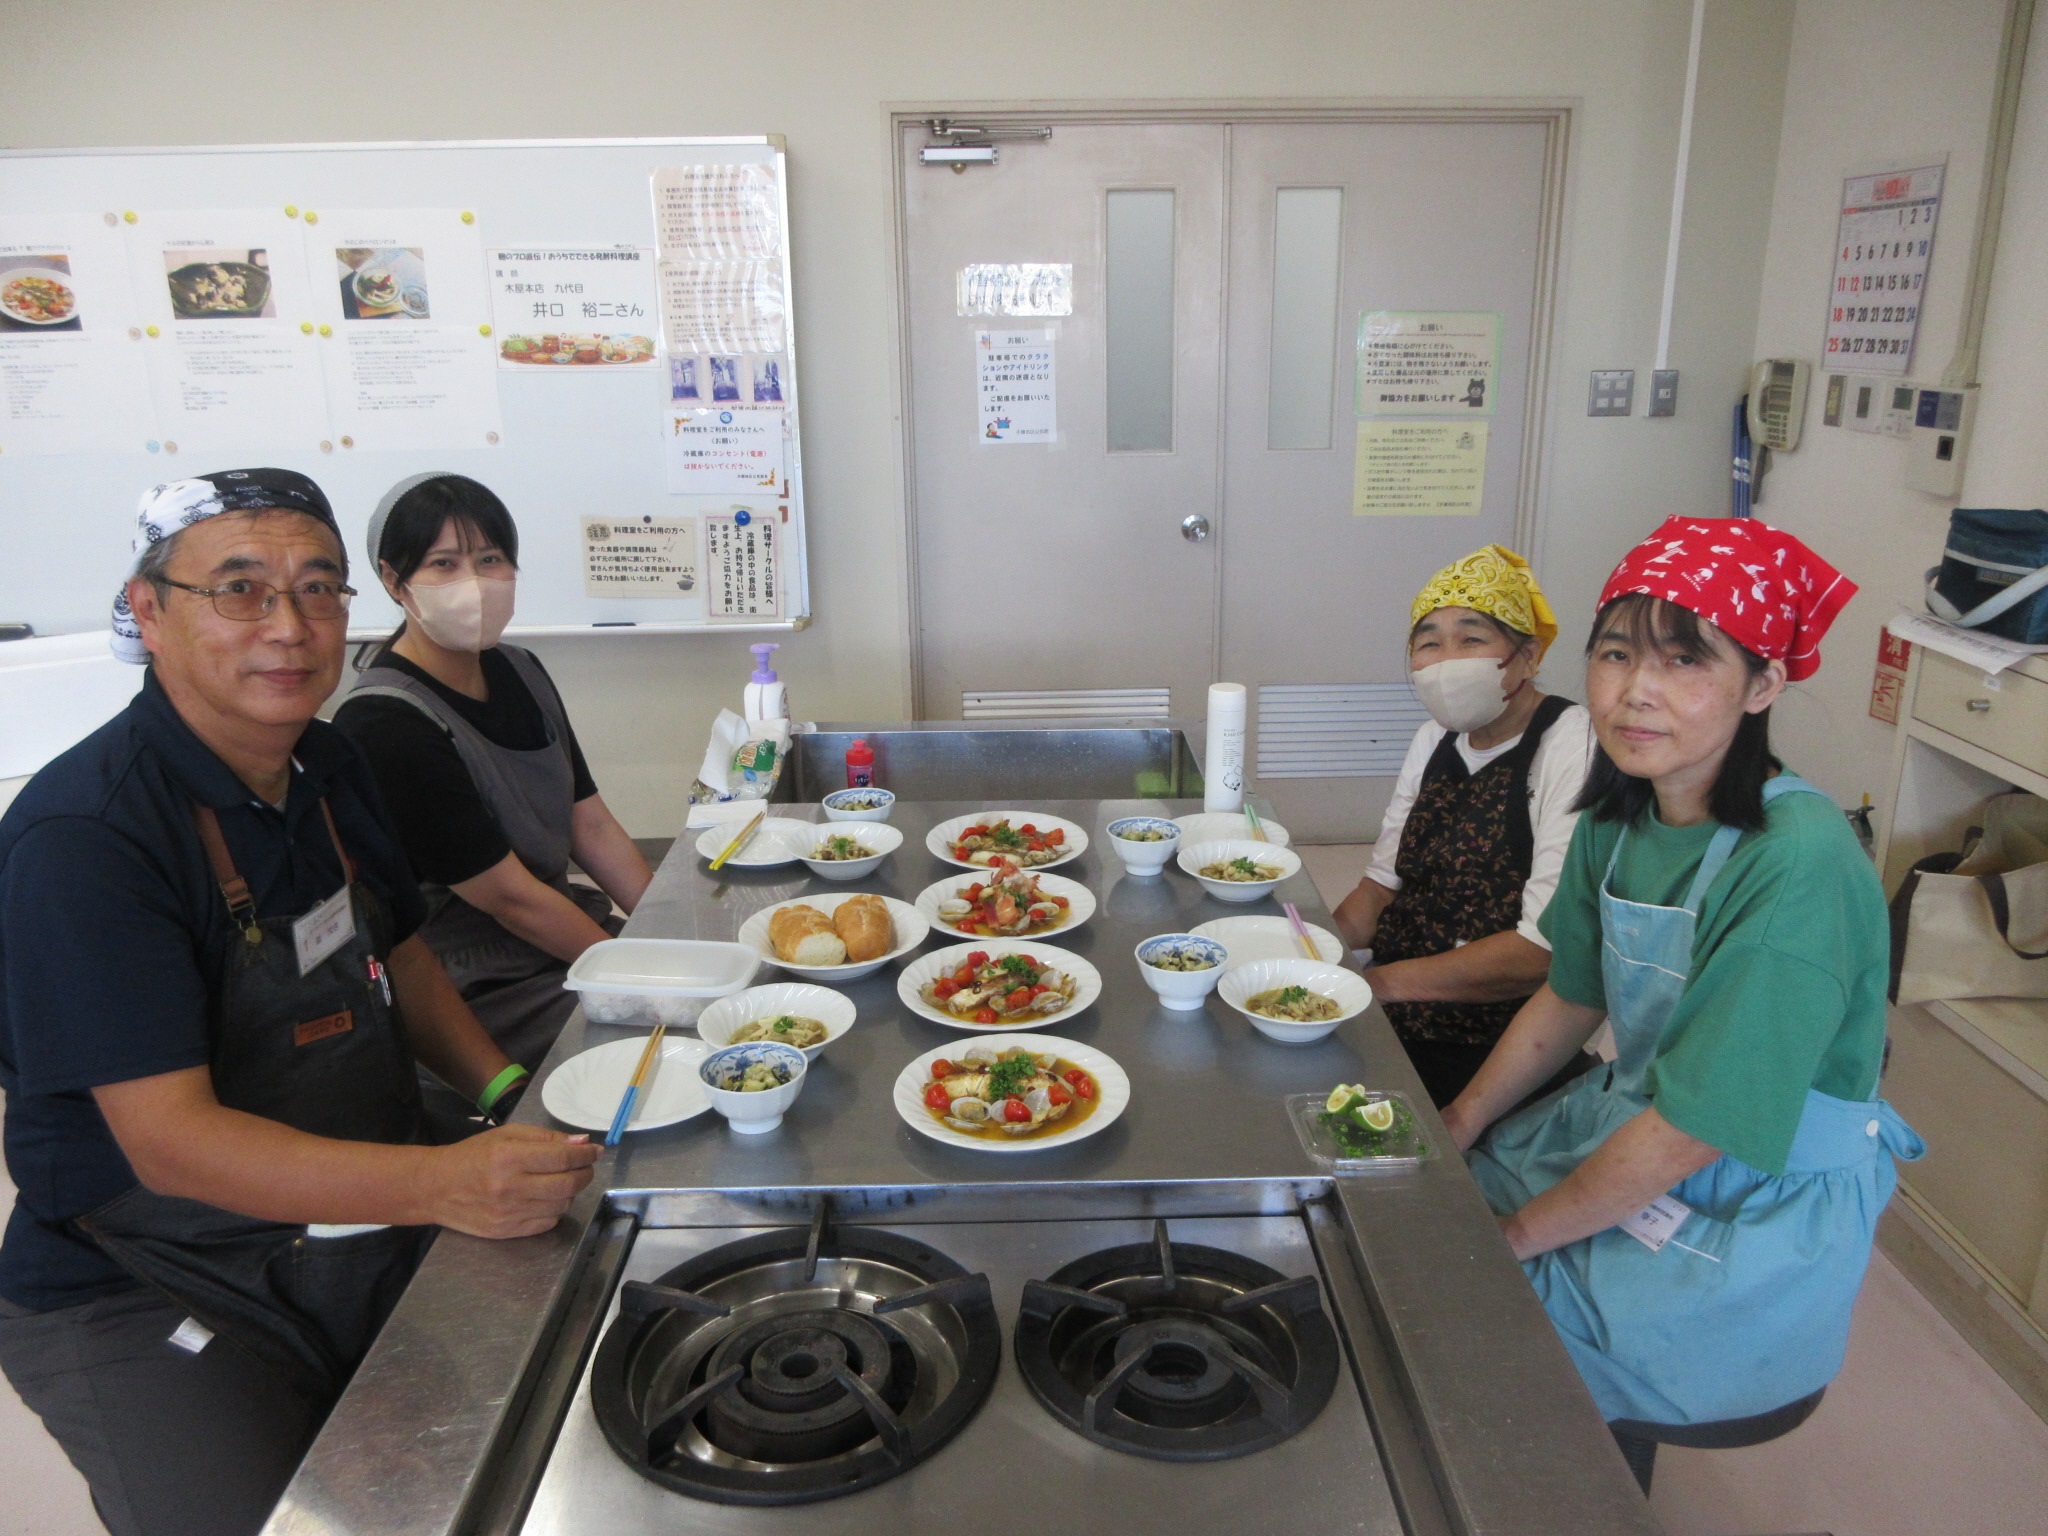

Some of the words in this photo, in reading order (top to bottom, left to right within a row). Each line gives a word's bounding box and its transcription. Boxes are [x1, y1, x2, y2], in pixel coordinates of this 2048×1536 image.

[1899, 211, 1902, 225] 1
[1910, 208, 1918, 224] 2
[1924, 207, 1931, 223] 3
[1843, 247, 1848, 260] 4
[1855, 246, 1861, 260] 5
[1868, 245, 1874, 259] 6
[1880, 244, 1887, 259] 7
[1893, 243, 1899, 258] 8
[1907, 242, 1913, 256] 9
[1919, 241, 1928, 256] 10
[505, 284, 544, 293] 木屋本店
[554, 284, 584, 293] 九代目
[1838, 278, 1846, 291] 11
[1850, 276, 1859, 291] 12
[1863, 276, 1871, 290] 13
[1875, 276, 1884, 290] 14
[1888, 275, 1896, 290] 15
[1901, 275, 1909, 289] 16
[1913, 274, 1922, 289] 17
[533, 302, 564, 318] 井口
[582, 302, 644, 318] 裕二さん
[1833, 308, 1842, 322] 18
[1846, 308, 1855, 322] 19
[1858, 308, 1867, 322] 20
[1870, 307, 1879, 322] 21
[1882, 307, 1892, 322] 22
[1895, 307, 1905, 322] 23
[1906, 307, 1915, 322] 24
[1420, 324, 1444, 332] お願い
[1828, 338, 1839, 352] 25
[1841, 339, 1851, 352] 26
[1853, 339, 1863, 352] 27
[1865, 338, 1875, 352] 28
[1878, 338, 1888, 352] 29
[1890, 339, 1900, 353] 30
[1901, 339, 1908, 354] 31
[983, 363, 1049, 371] ションやアイドリング
[990, 394, 1050, 402] ご配慮をお願いいた
[614, 526, 686, 534] 料理室をご利用の方へ
[709, 524, 718, 557] 致します。
[722, 524, 732, 613] ますようご協力をお願い
[764, 525, 773, 605] 料理サークルの皆様へ
